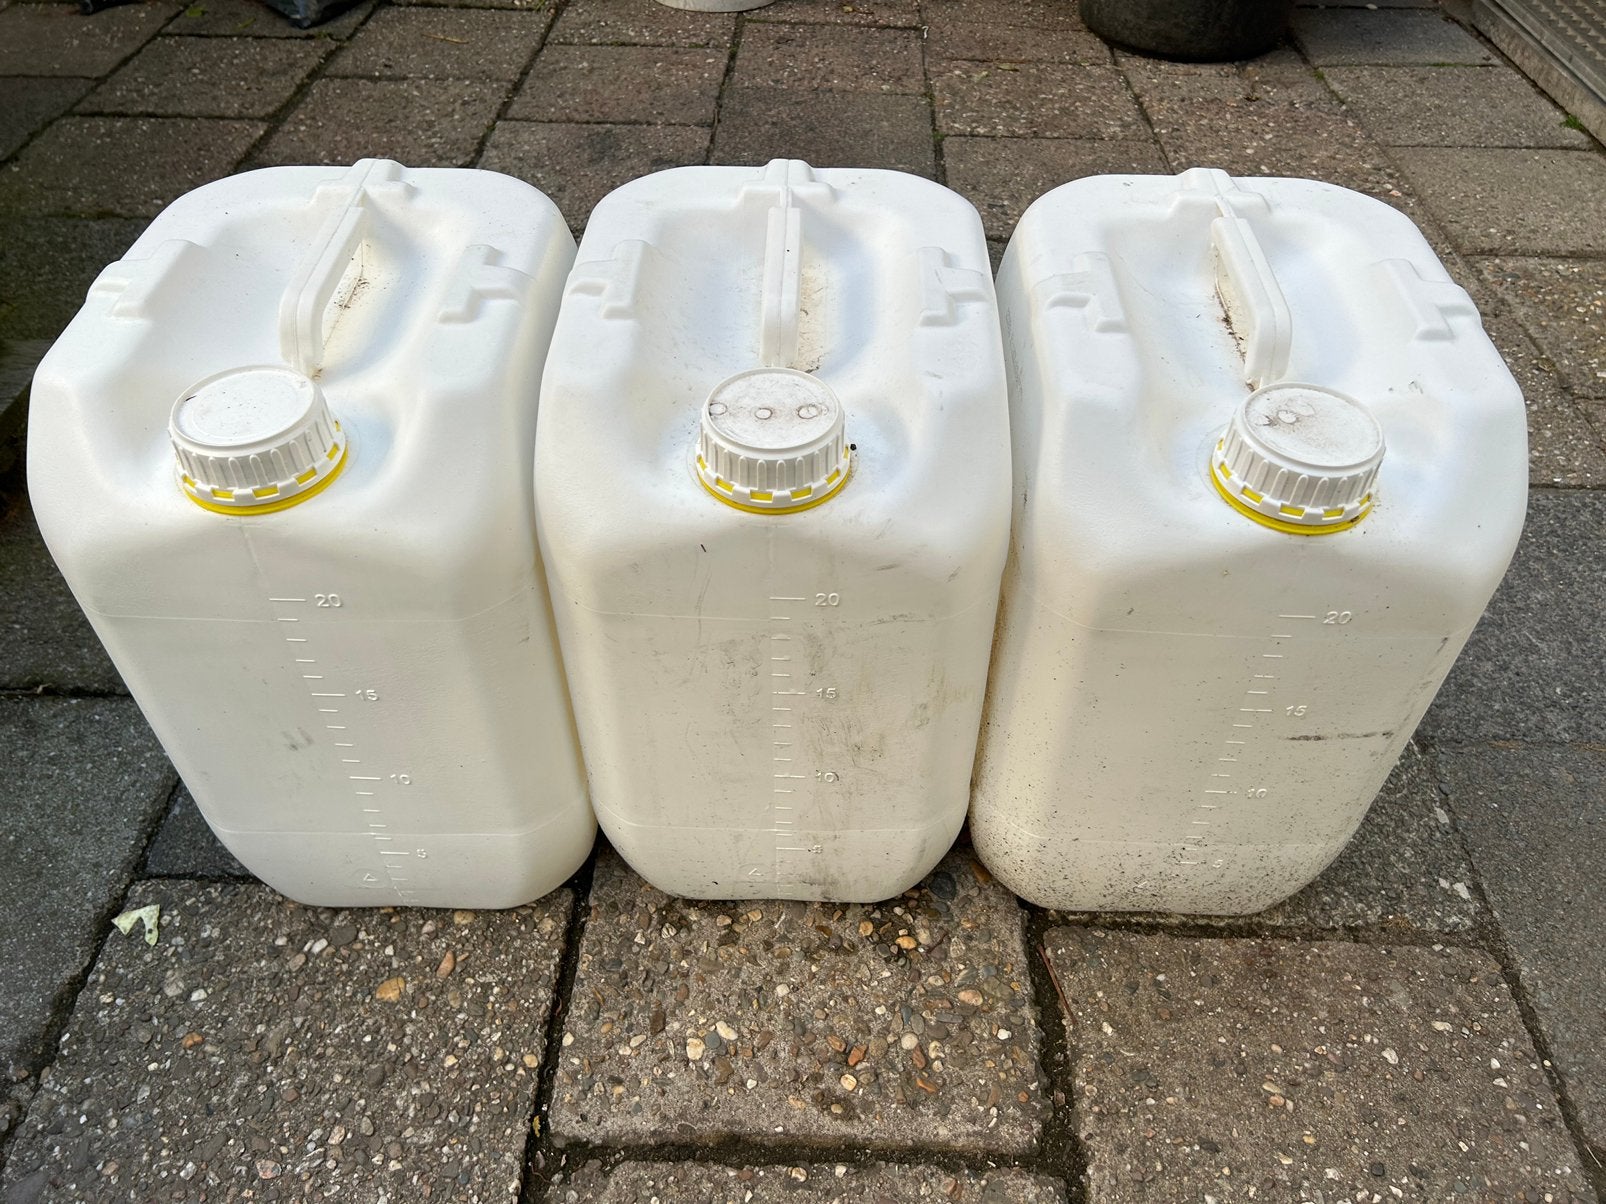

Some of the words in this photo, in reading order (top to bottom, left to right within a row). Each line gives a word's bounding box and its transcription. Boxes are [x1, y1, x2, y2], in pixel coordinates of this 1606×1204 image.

[315, 593, 342, 608] 20
[815, 592, 840, 607] 20
[1322, 611, 1352, 625] 20
[355, 689, 379, 701] 15
[816, 687, 838, 700] 15
[1286, 705, 1308, 717] 15
[390, 774, 411, 785] 10
